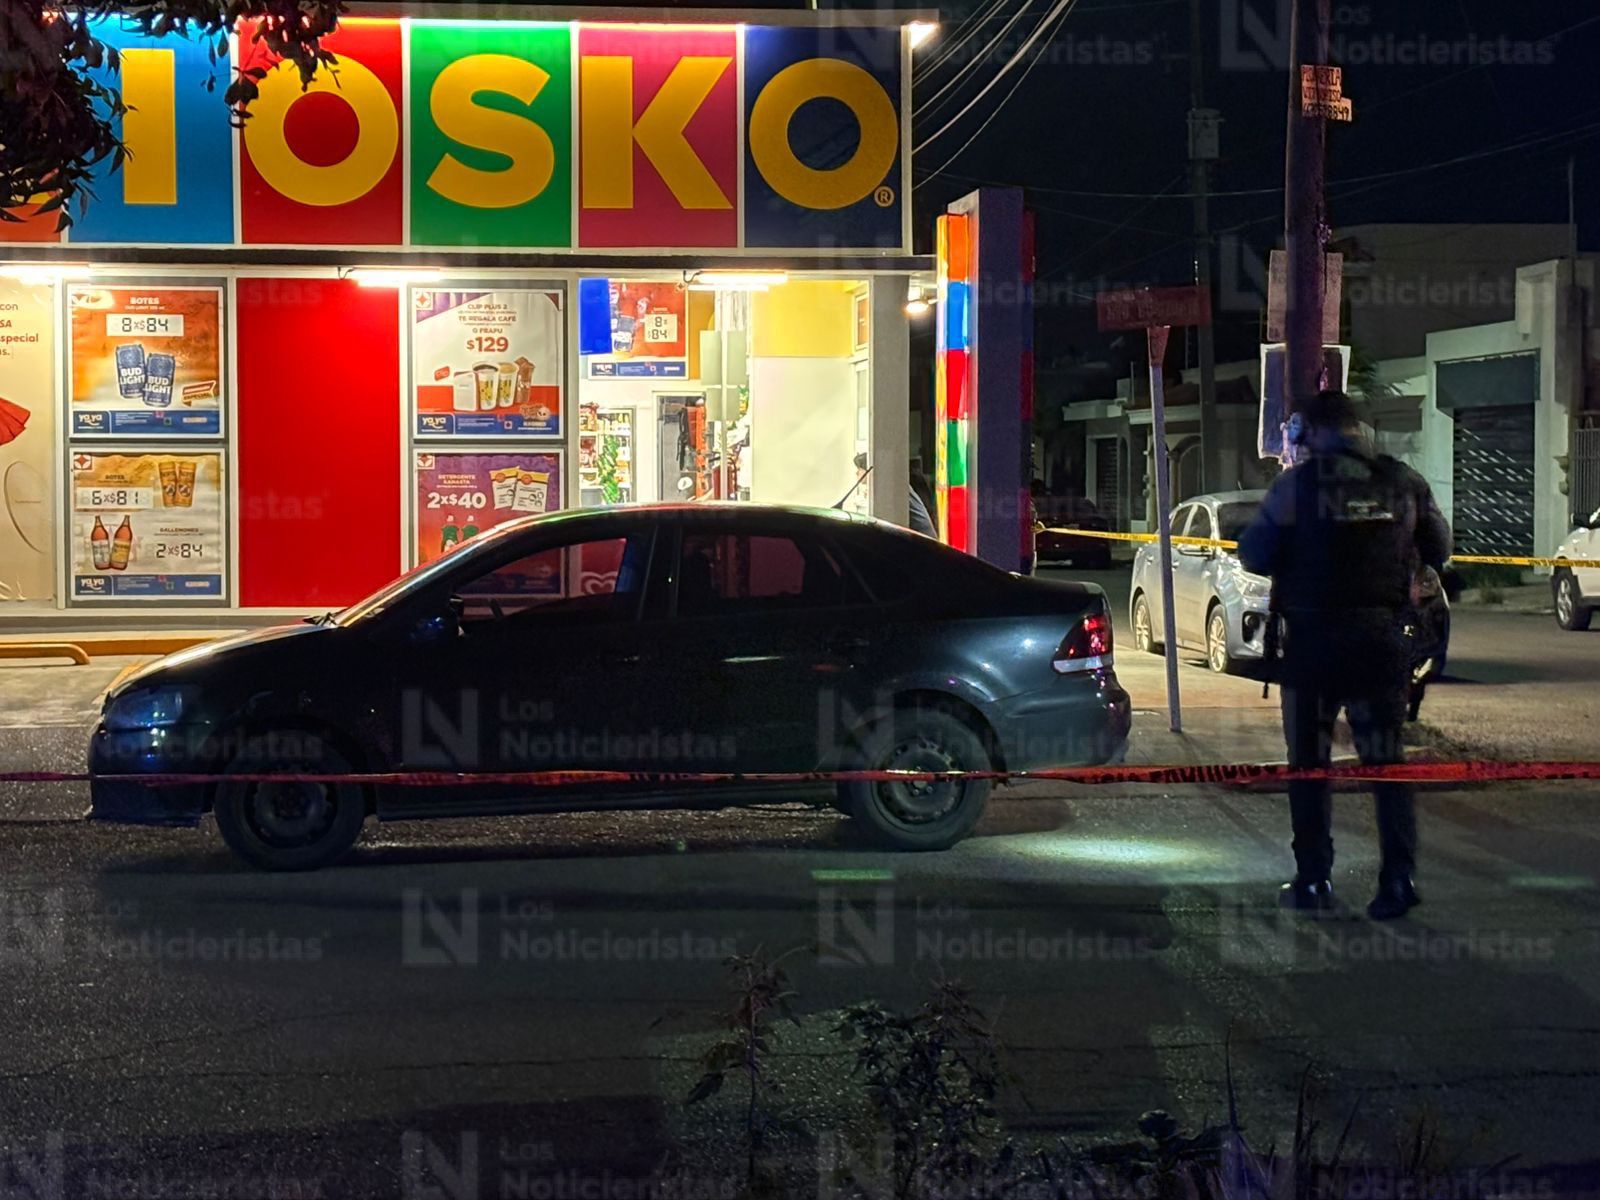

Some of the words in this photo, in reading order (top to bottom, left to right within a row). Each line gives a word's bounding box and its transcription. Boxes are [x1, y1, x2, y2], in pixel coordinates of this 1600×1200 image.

[26, 52, 902, 211] IOSKO
[130, 297, 160, 305] BOTES
[0, 333, 39, 344] special
[466, 336, 509, 352] $129
[120, 367, 142, 377] BUD
[120, 374, 146, 385] LIGHT
[147, 376, 169, 386] BUD
[143, 384, 171, 394] LIGHT
